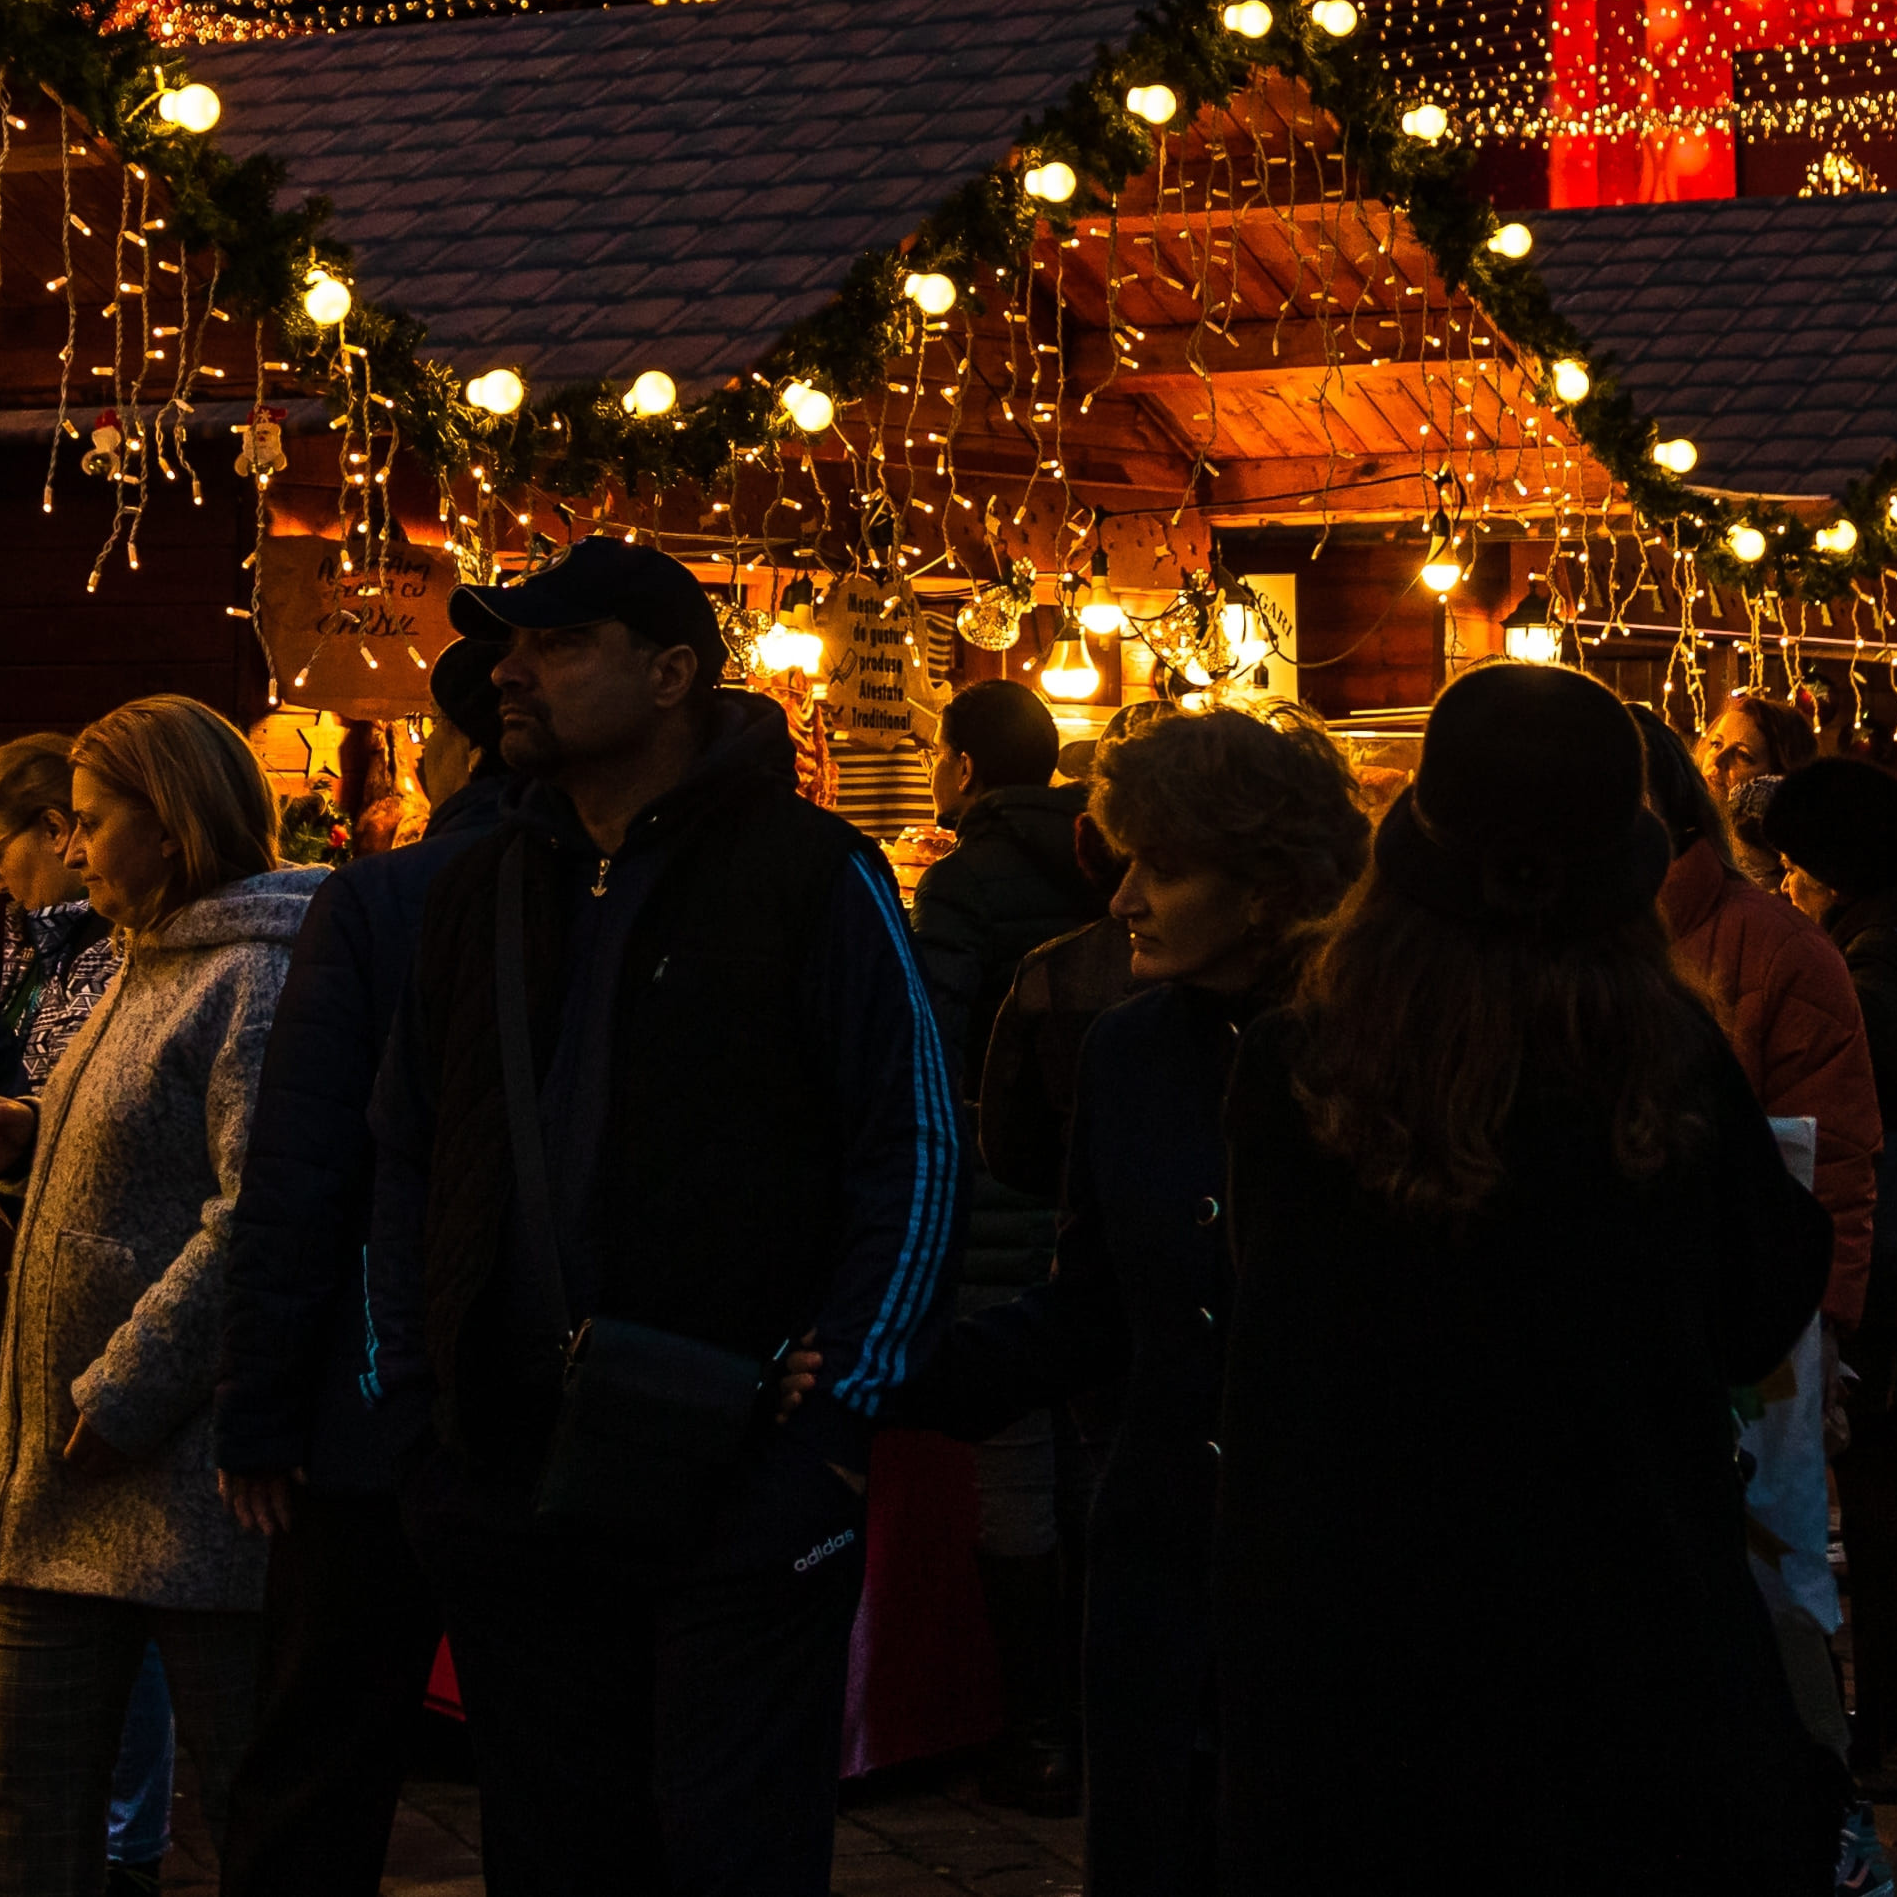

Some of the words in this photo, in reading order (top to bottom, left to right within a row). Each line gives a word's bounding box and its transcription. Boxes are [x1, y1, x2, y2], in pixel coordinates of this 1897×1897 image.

[853, 625, 866, 642] de
[859, 651, 903, 675] produse
[859, 679, 903, 701] Atestate
[793, 1528, 855, 1572] adidas
